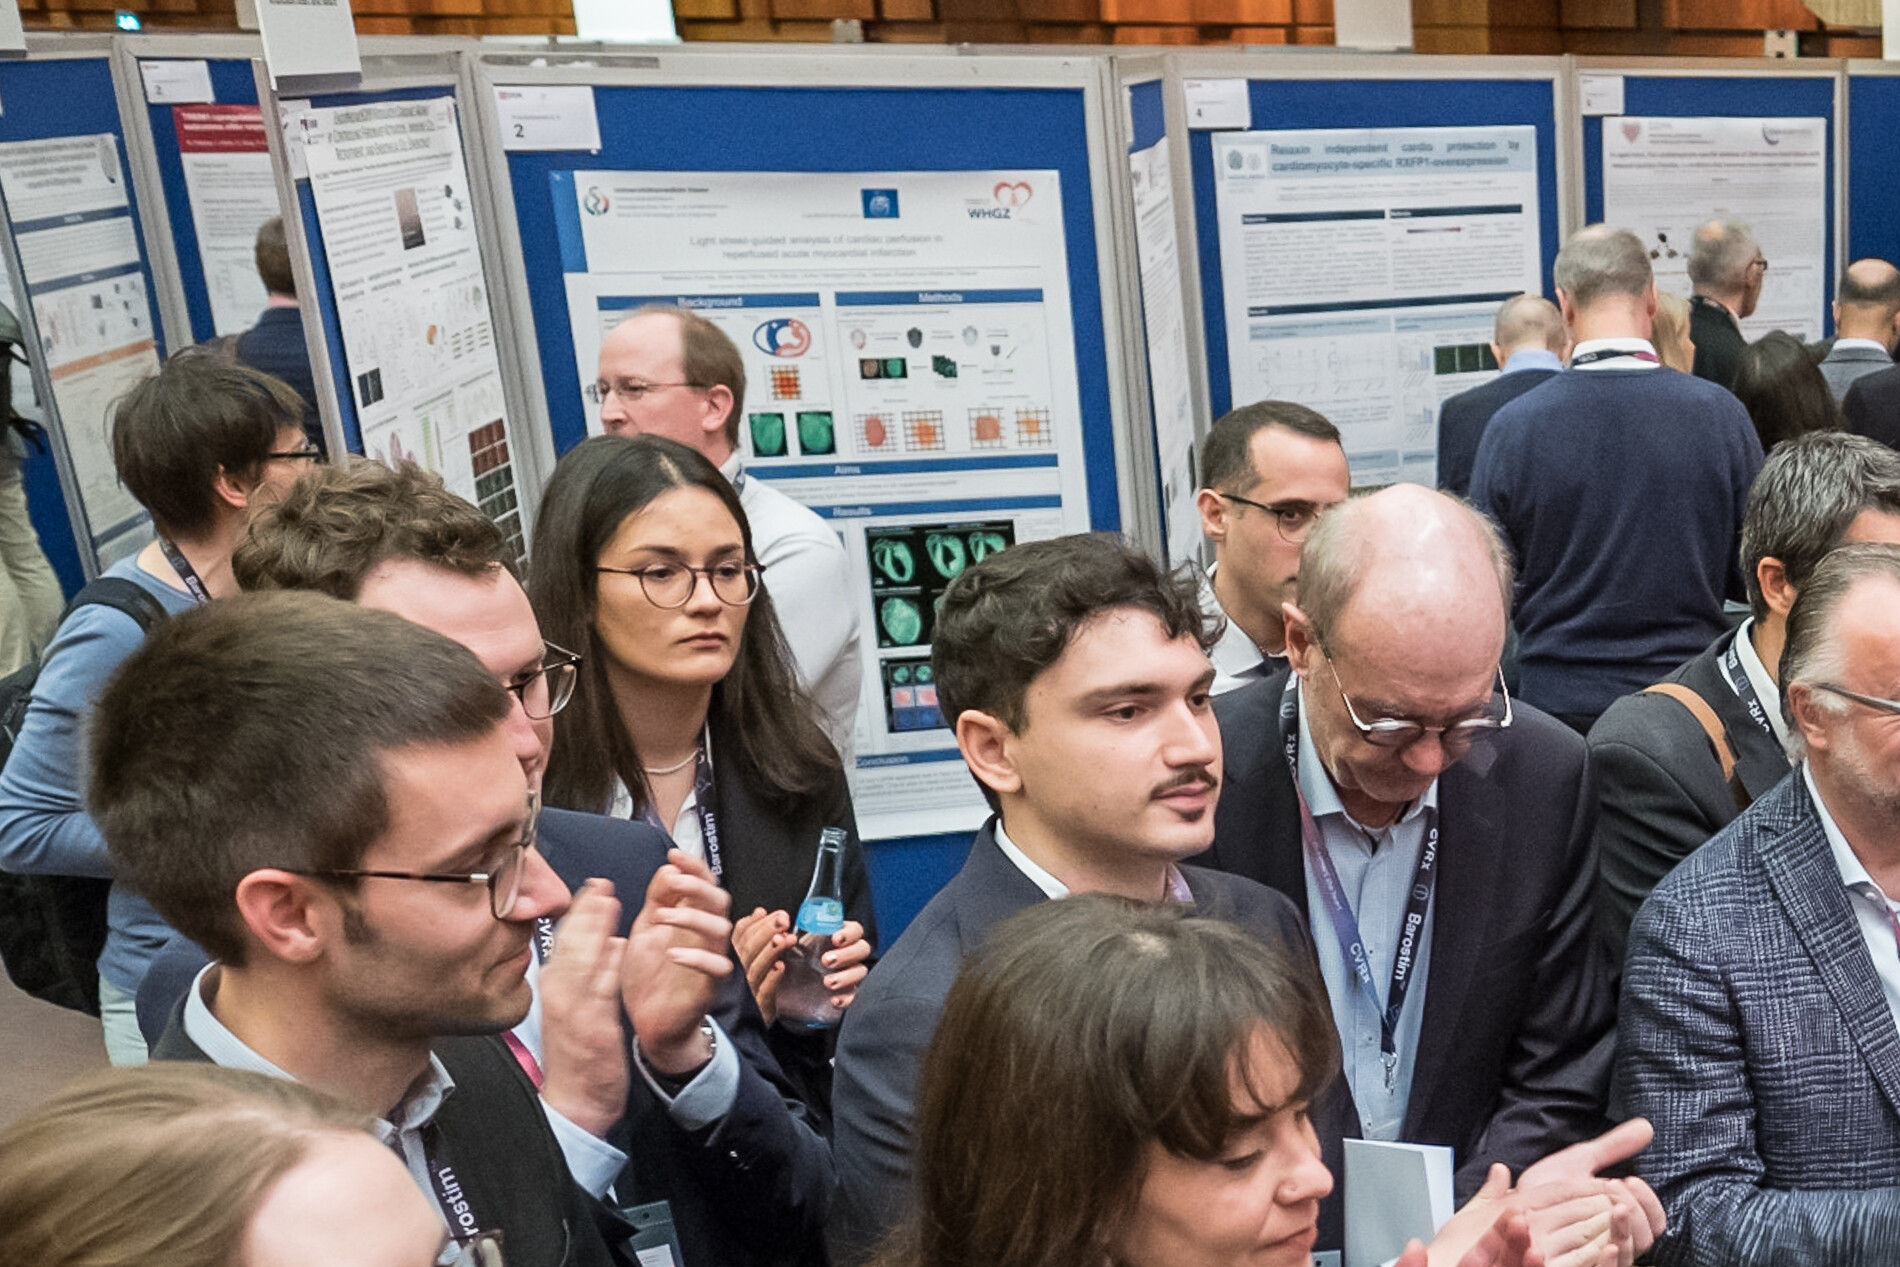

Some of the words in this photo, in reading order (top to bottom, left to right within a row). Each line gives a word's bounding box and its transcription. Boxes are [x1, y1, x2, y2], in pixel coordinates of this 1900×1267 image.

[514, 124, 525, 138] 2
[968, 207, 1011, 220] WHGZ
[918, 292, 963, 303] Methods
[1286, 734, 1296, 778] CVRx
[704, 812, 722, 875] Barostim
[1420, 828, 1439, 870] CVRx
[1350, 943, 1371, 984] CVRx
[1395, 912, 1422, 981] Barostim
